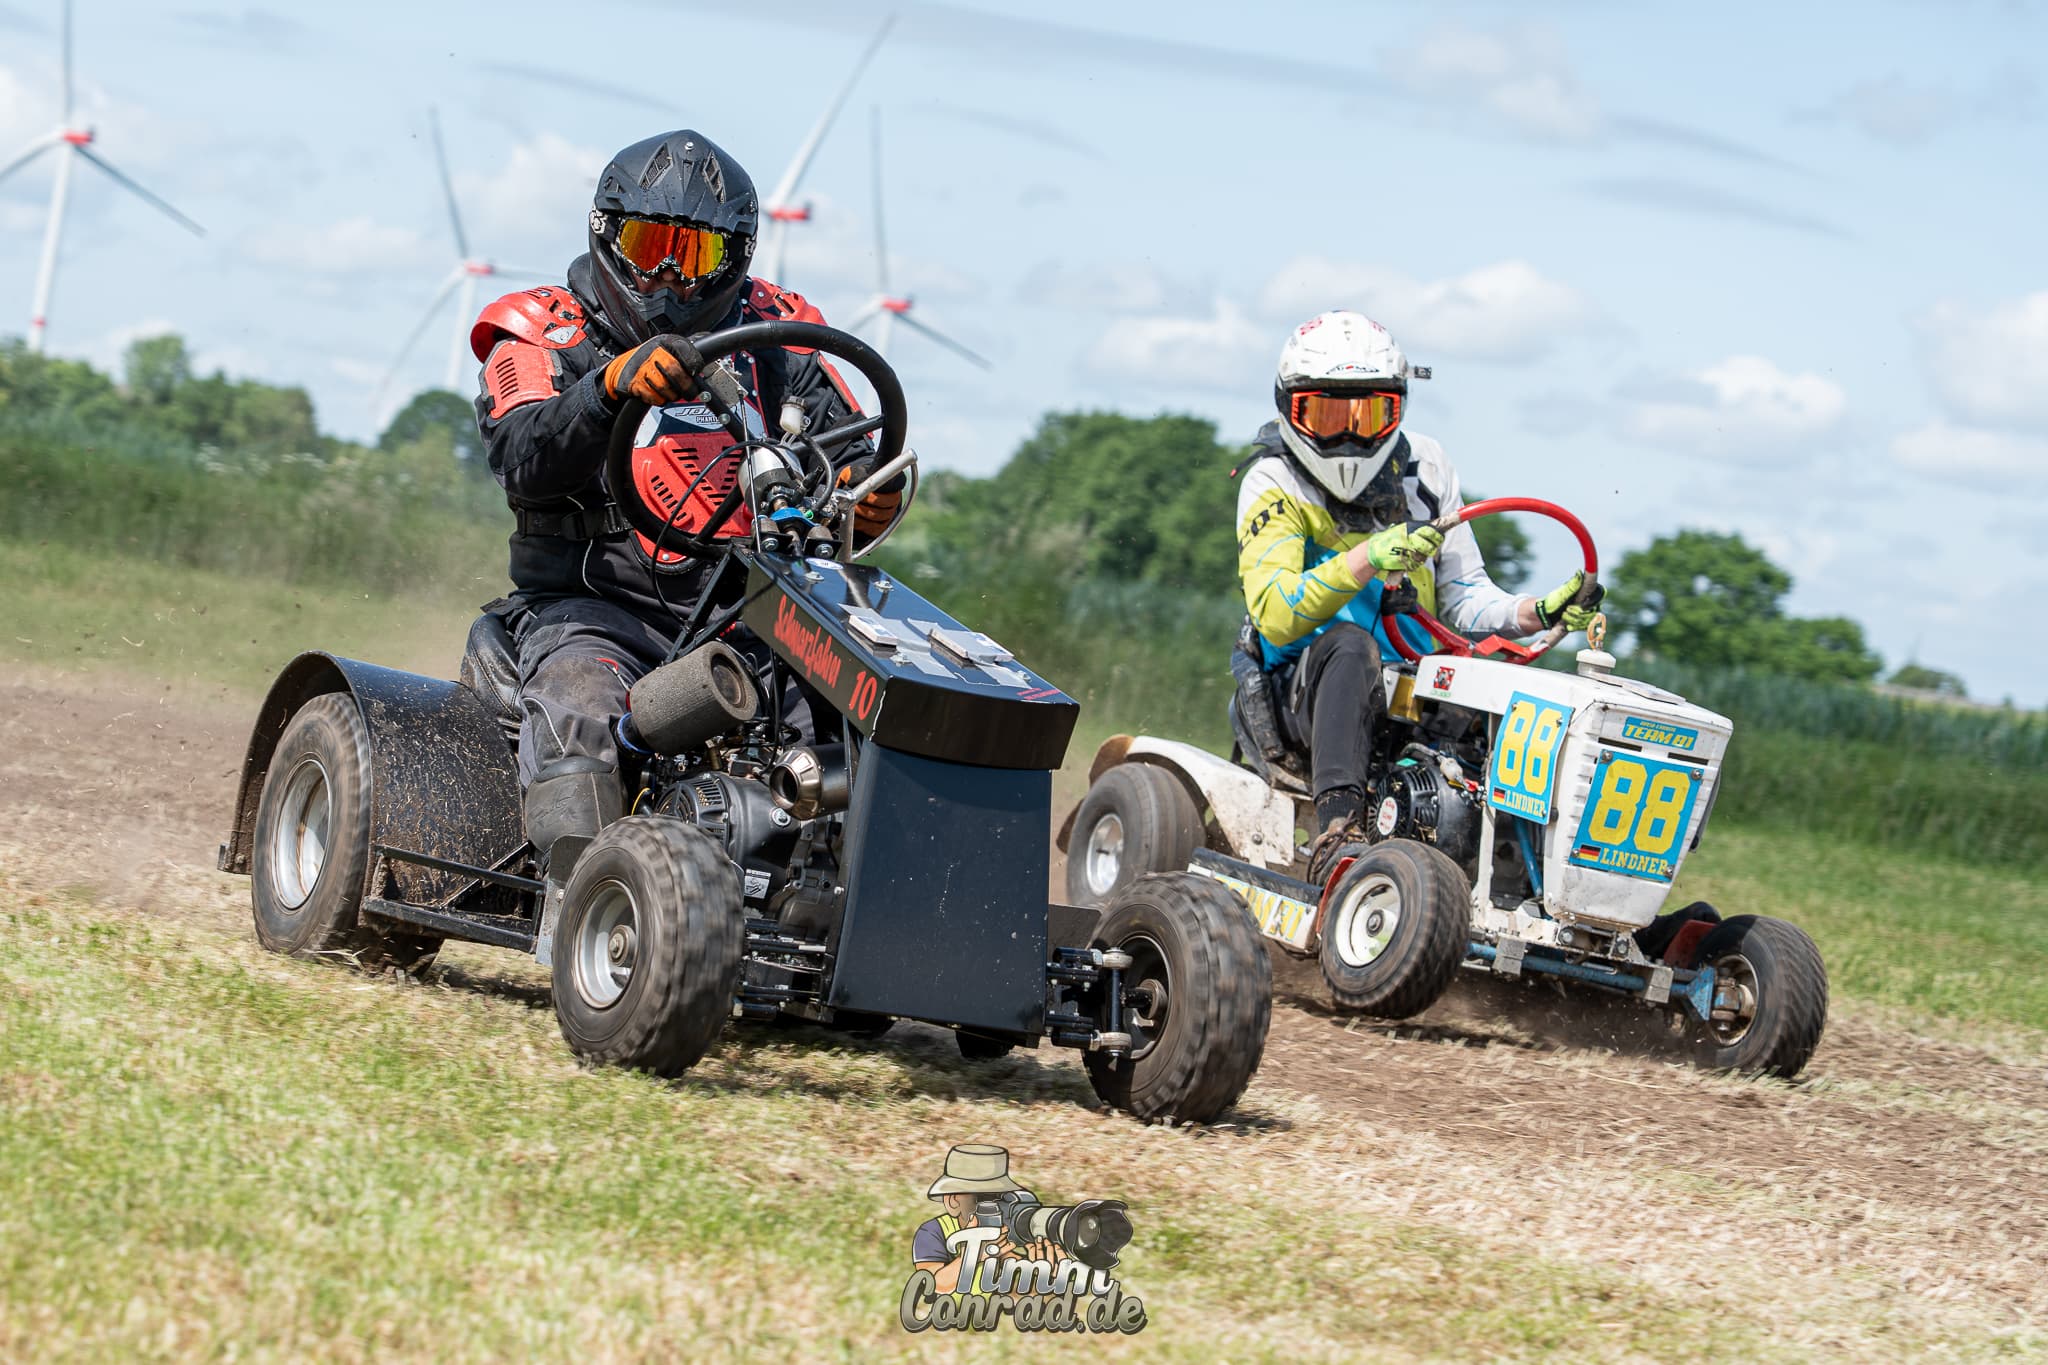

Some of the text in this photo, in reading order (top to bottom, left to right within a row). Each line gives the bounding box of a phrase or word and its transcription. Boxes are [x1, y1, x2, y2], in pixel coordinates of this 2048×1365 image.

[848, 671, 878, 720] 10
[1497, 700, 1563, 795] 88
[1625, 724, 1674, 744] TEAM
[1588, 759, 1691, 854] 88
